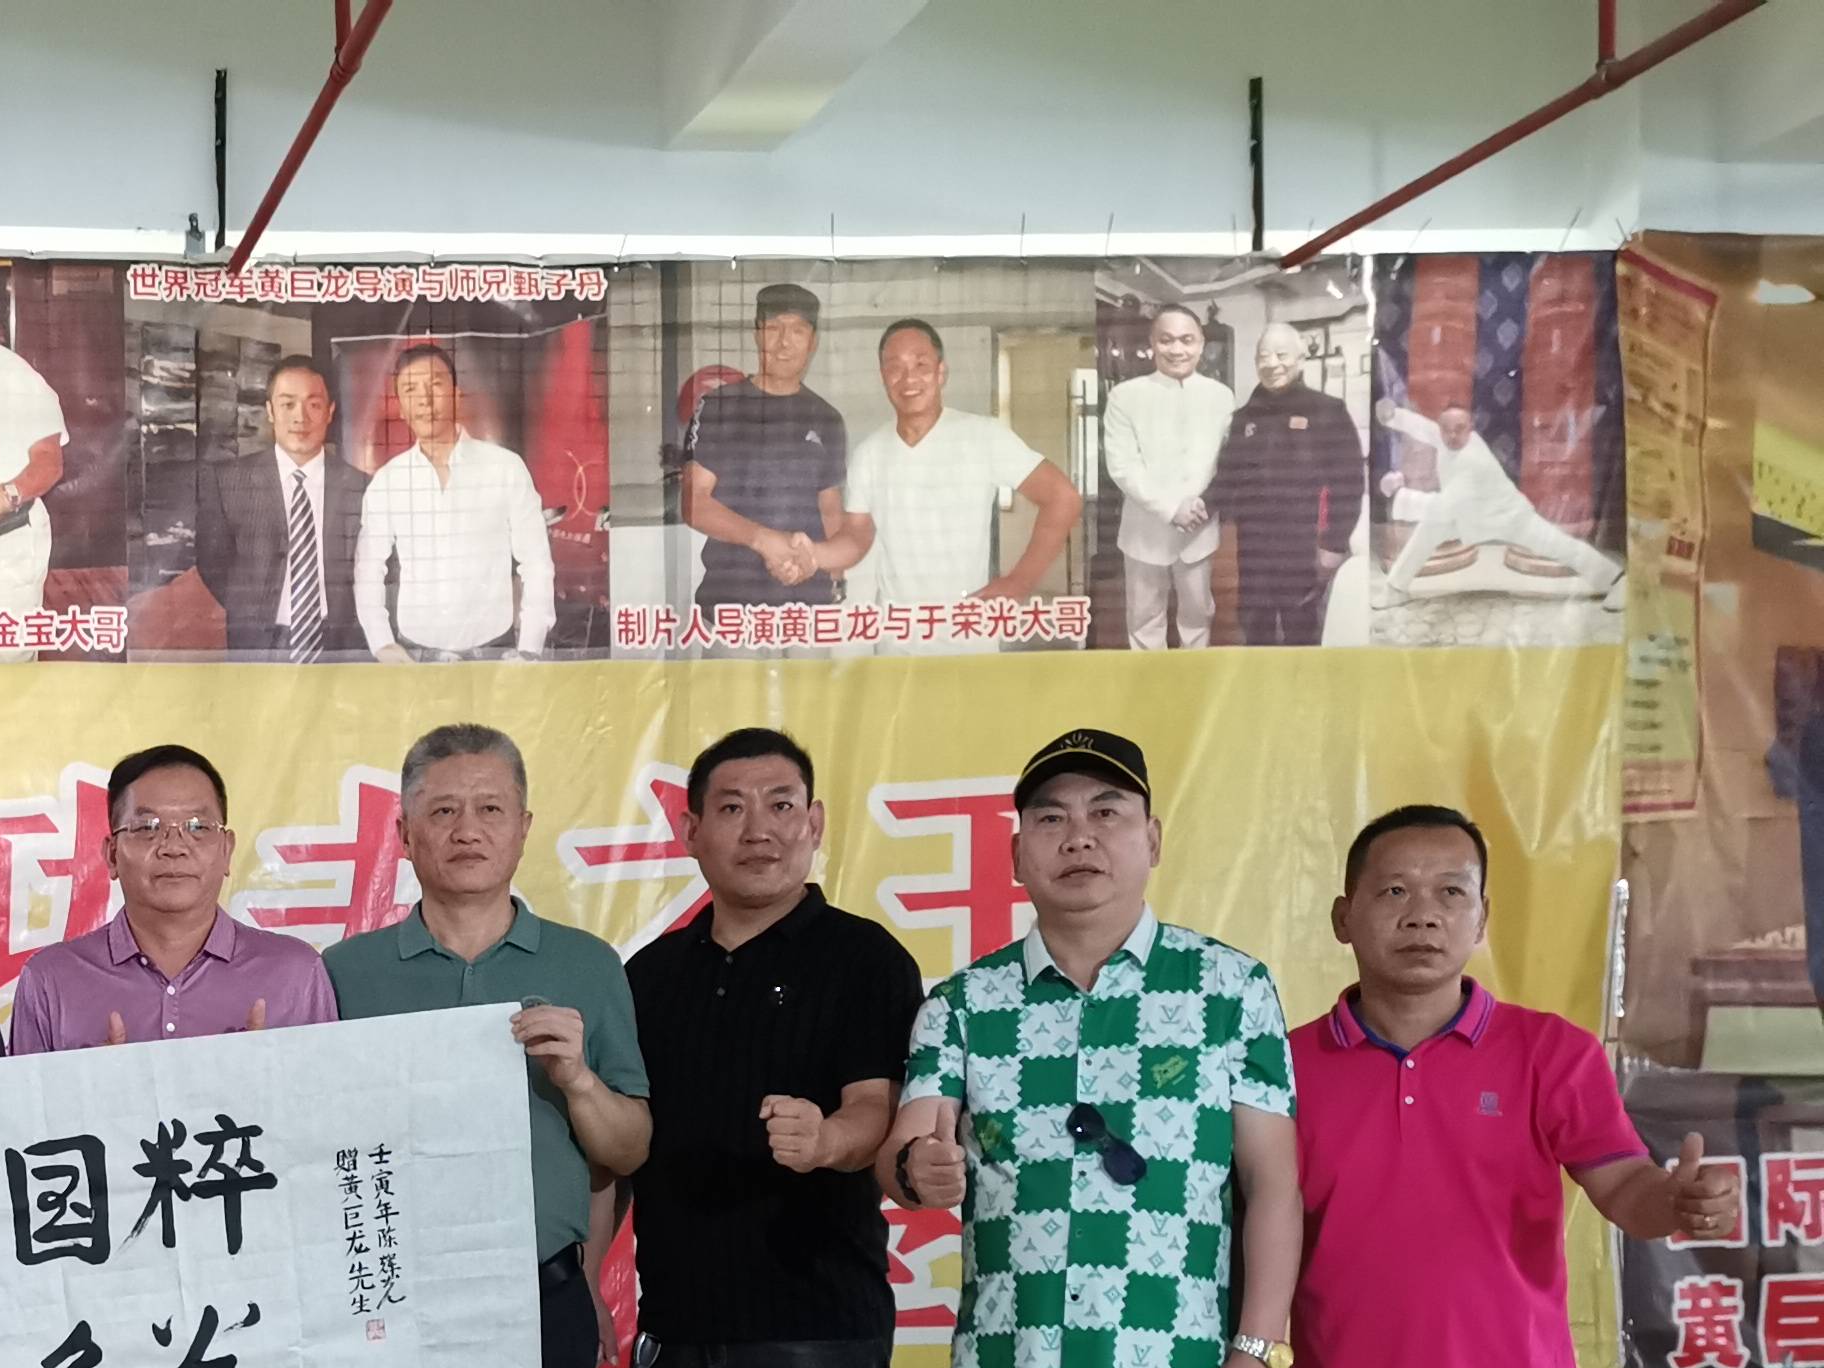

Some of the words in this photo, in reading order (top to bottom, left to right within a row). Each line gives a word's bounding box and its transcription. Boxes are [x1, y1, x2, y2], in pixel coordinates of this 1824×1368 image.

[129, 265, 608, 303] 世界冠军黄巨龙导演与师兄甄子丹
[616, 598, 1092, 649] 制片人导演黄巨龙与于荣光大哥
[1666, 1153, 1824, 1249] 际
